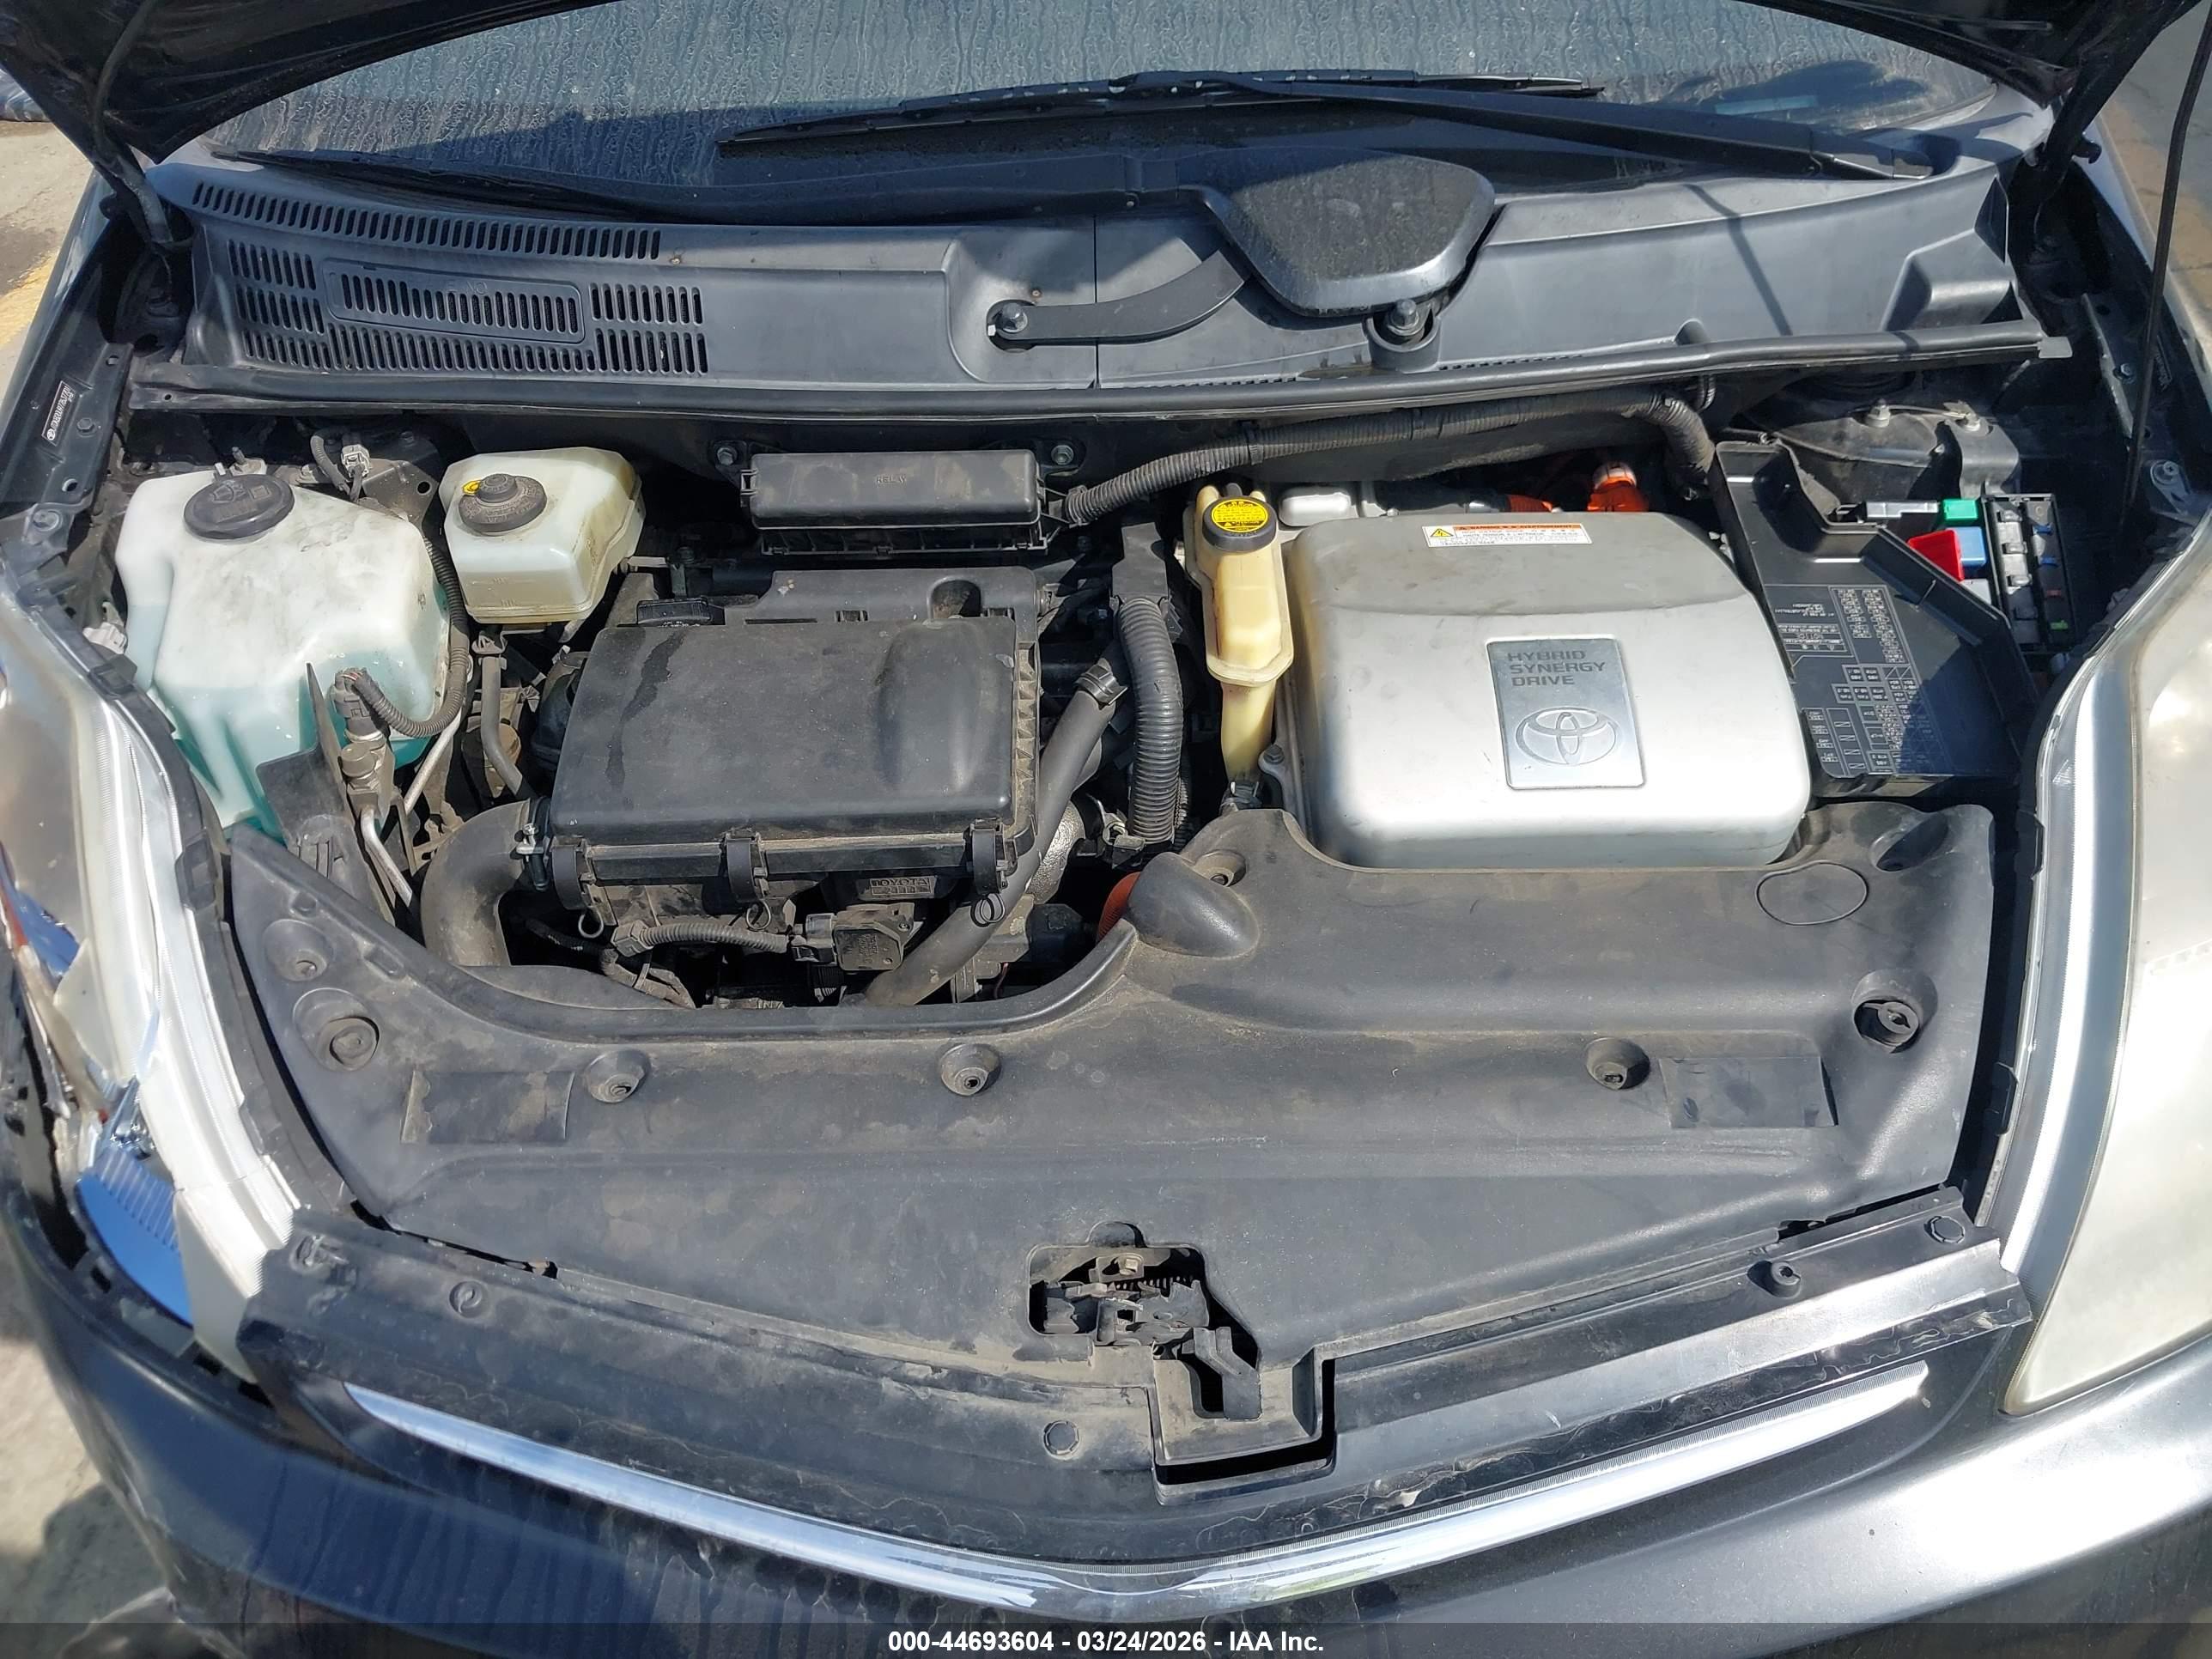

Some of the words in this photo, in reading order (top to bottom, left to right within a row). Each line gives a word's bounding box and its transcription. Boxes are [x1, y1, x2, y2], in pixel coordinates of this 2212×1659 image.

[1508, 650, 1586, 661] HYBRID
[1510, 661, 1606, 674] SYNERGY
[1512, 674, 1575, 687] DRIVE
[872, 878, 929, 886] TOYOTA
